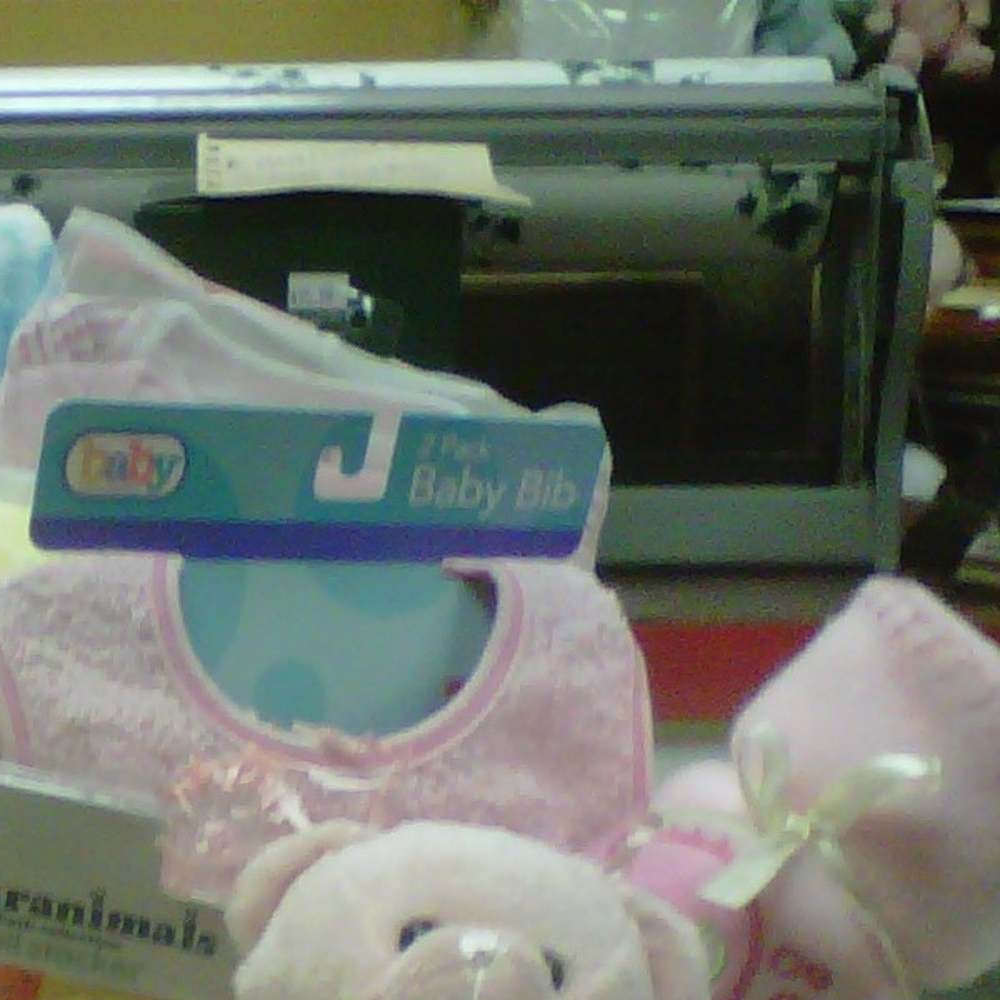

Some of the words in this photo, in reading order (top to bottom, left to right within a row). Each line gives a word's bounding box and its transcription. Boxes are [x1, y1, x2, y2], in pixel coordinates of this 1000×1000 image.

[80, 438, 183, 492] baby
[409, 463, 507, 520] Baby
[514, 466, 577, 511] Bib
